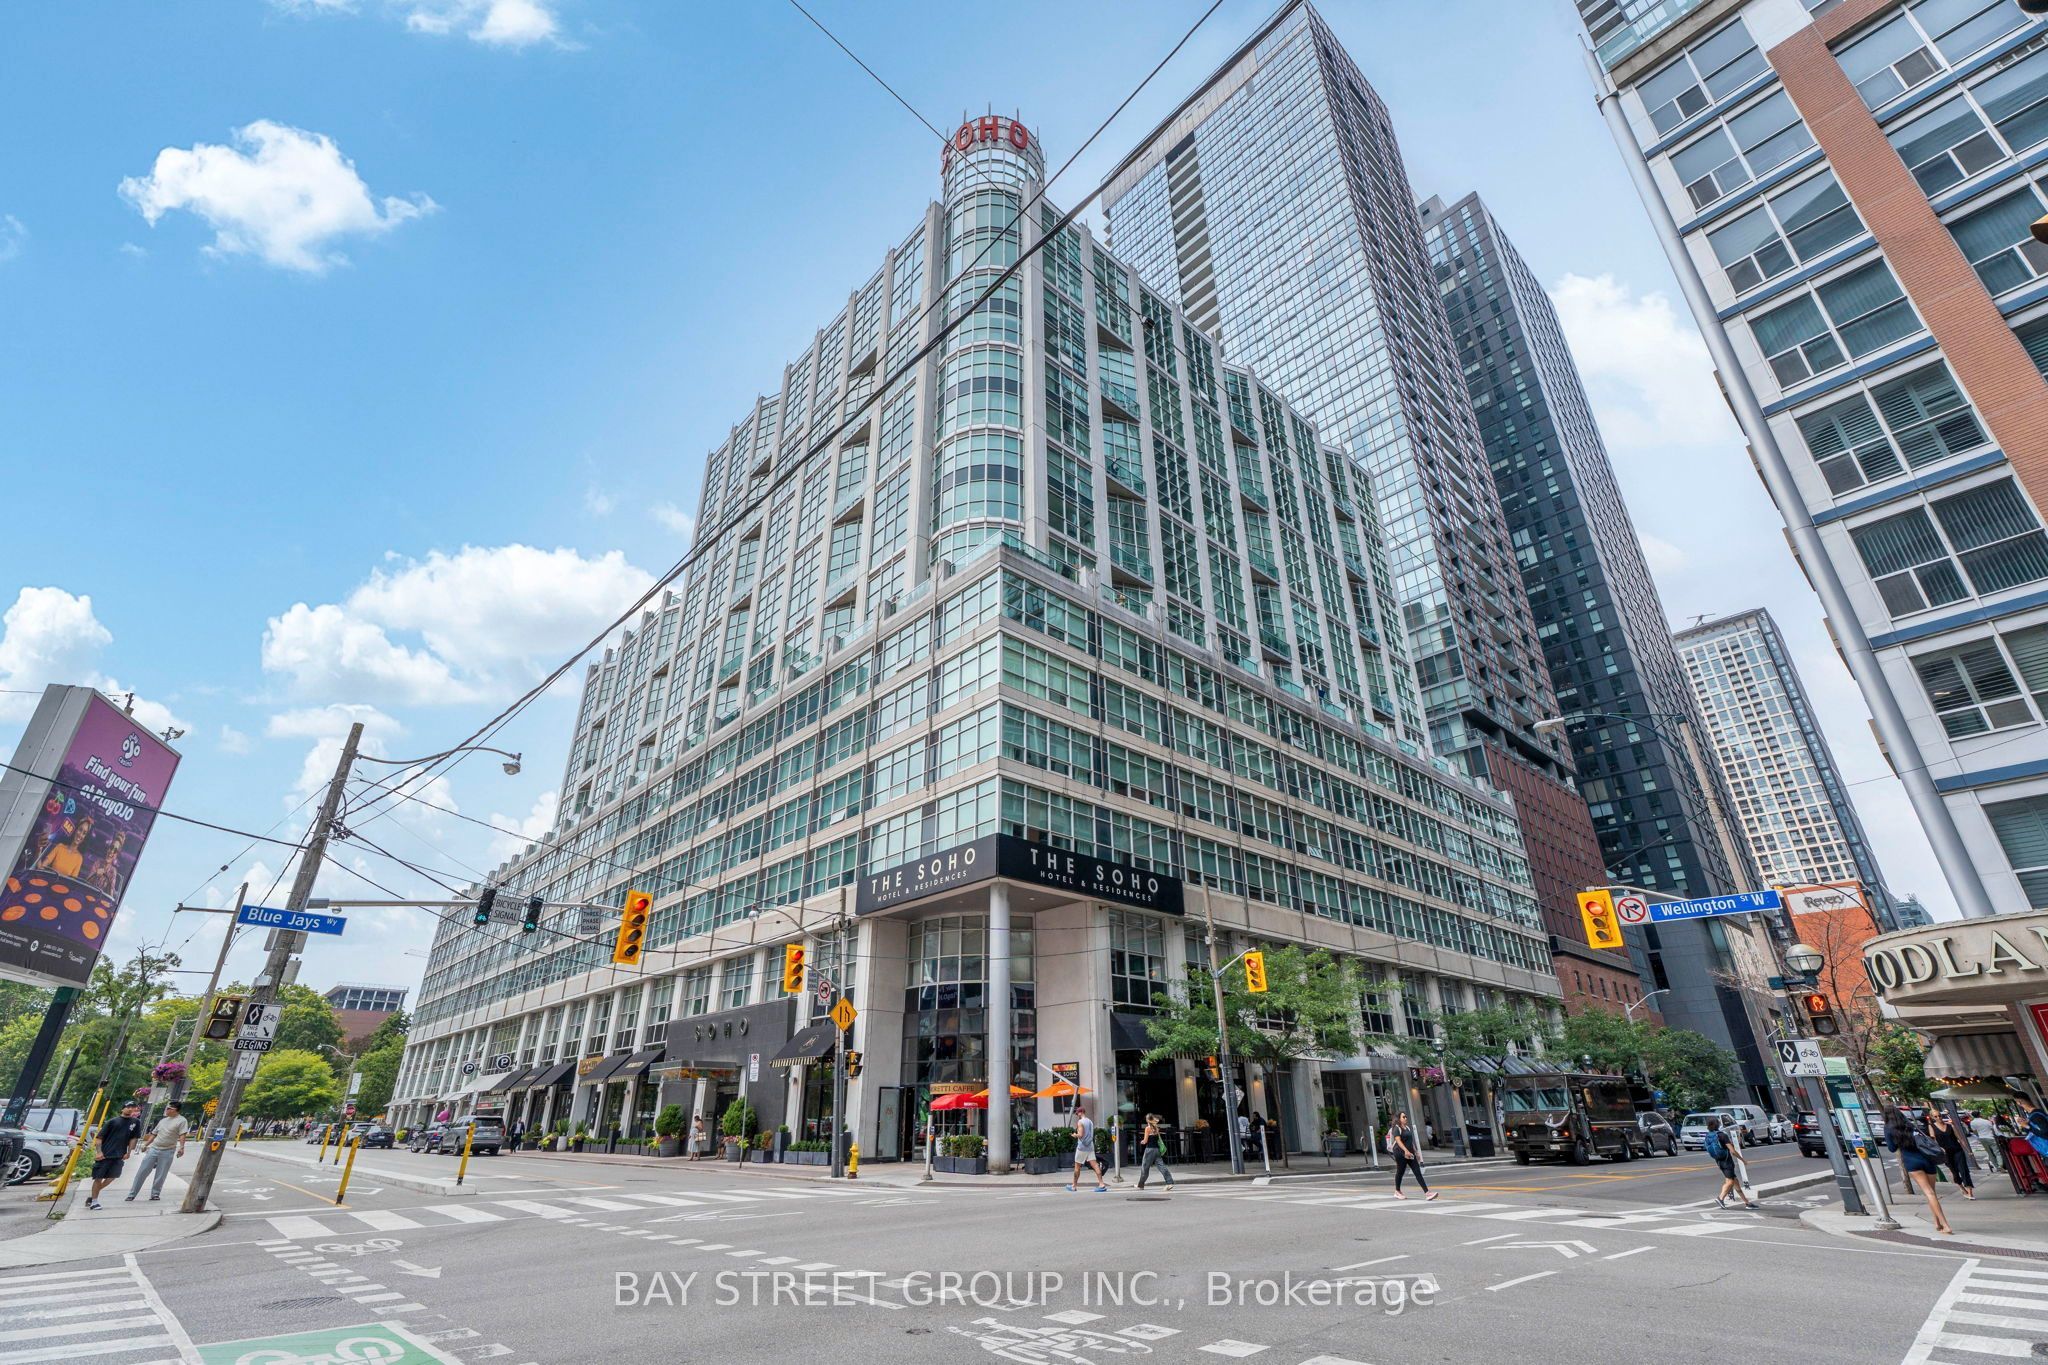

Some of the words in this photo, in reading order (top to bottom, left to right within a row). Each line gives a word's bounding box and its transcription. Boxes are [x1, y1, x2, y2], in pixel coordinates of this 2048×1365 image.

[85, 755, 112, 781] Find
[106, 772, 132, 793] your
[127, 783, 147, 803] fun
[80, 784, 95, 799] at
[872, 871, 902, 894] THE
[917, 847, 976, 880] SOHO
[1030, 848, 1075, 874] THE
[1096, 864, 1159, 893] SOHO
[877, 891, 901, 902] HOTEL
[914, 870, 968, 892] RESIDENCES
[1040, 870, 1073, 884] HOTEL
[1093, 882, 1152, 902] RESIDENCES
[493, 910, 518, 921] SIGNAL
[495, 900, 523, 910] BICYCLE
[1660, 897, 1737, 917] Wellington
[1751, 893, 1765, 906] W
[247, 908, 282, 924] Blue
[287, 914, 321, 930] Jays
[326, 917, 338, 927] Wy
[237, 1040, 269, 1051] BEGINS
